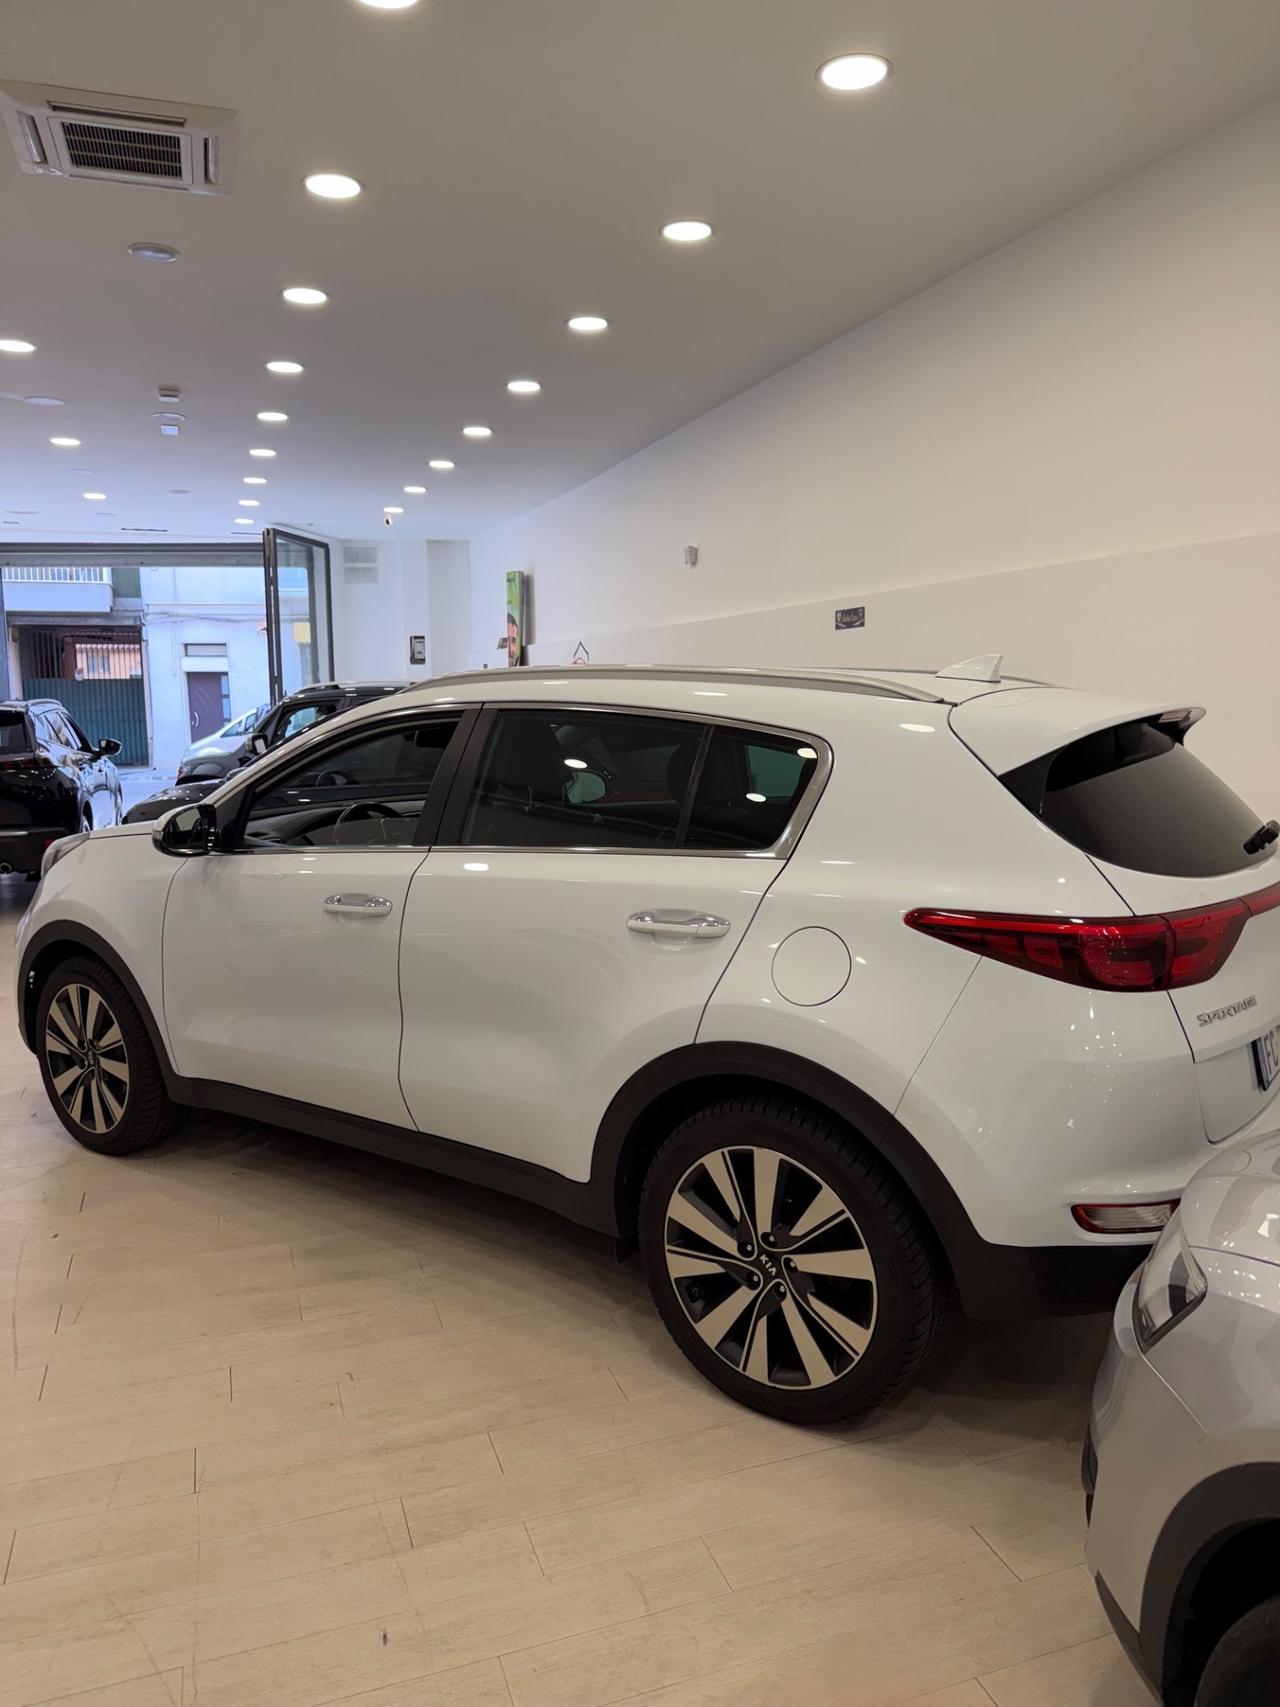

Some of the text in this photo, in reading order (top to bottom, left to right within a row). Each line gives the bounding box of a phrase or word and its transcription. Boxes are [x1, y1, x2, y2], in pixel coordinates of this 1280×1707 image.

[1196, 994, 1258, 1027] SPORTAGE
[1264, 1024, 1280, 1075] FC
[760, 1254, 776, 1276] KIA
